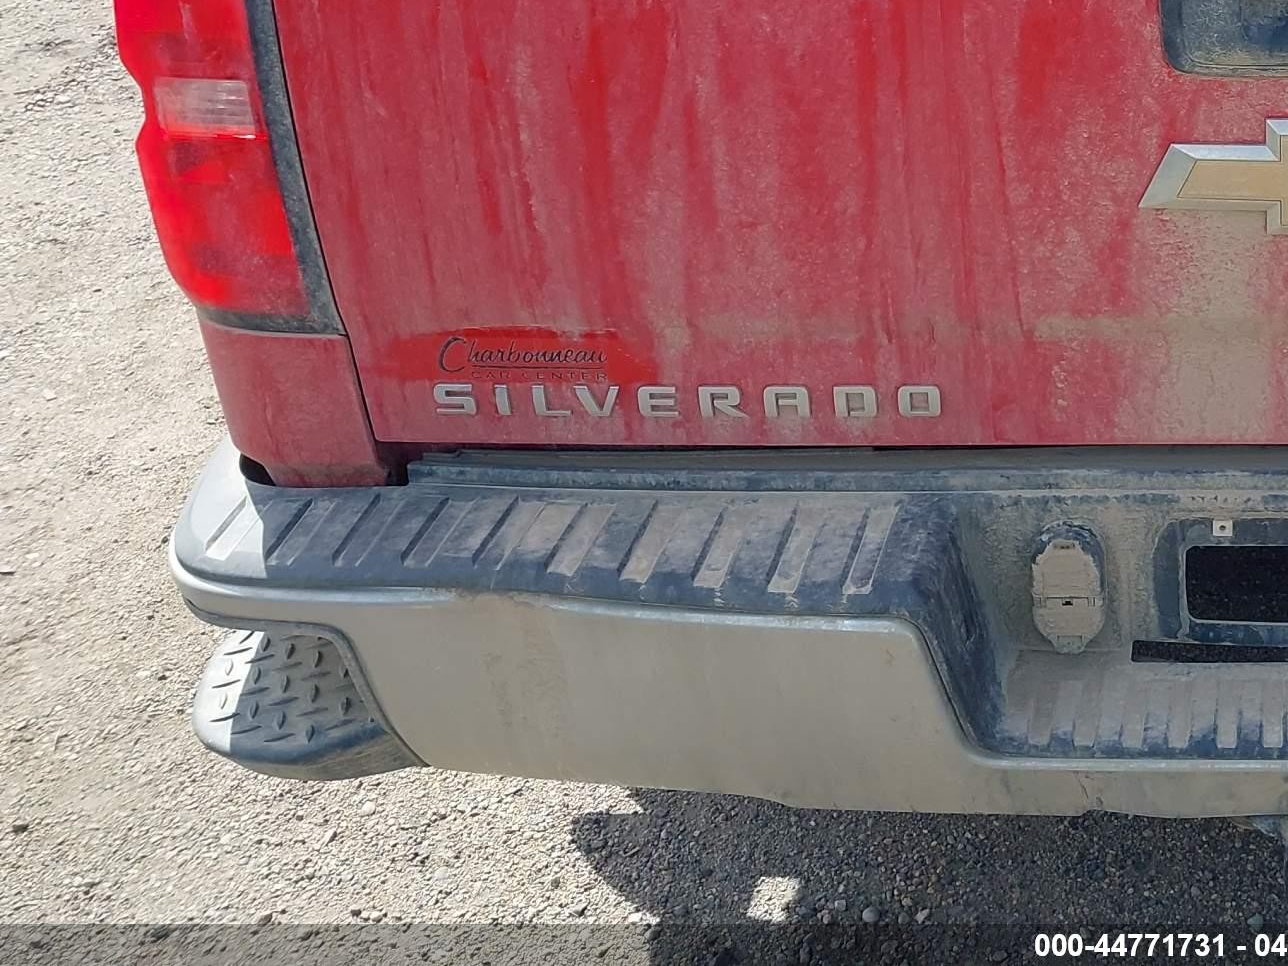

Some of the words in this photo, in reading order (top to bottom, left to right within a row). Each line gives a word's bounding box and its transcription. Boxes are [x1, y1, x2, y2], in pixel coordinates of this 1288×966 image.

[439, 336, 608, 373] Charbonneau
[522, 370, 608, 381] CENTER
[432, 382, 943, 419] SILVERADO
